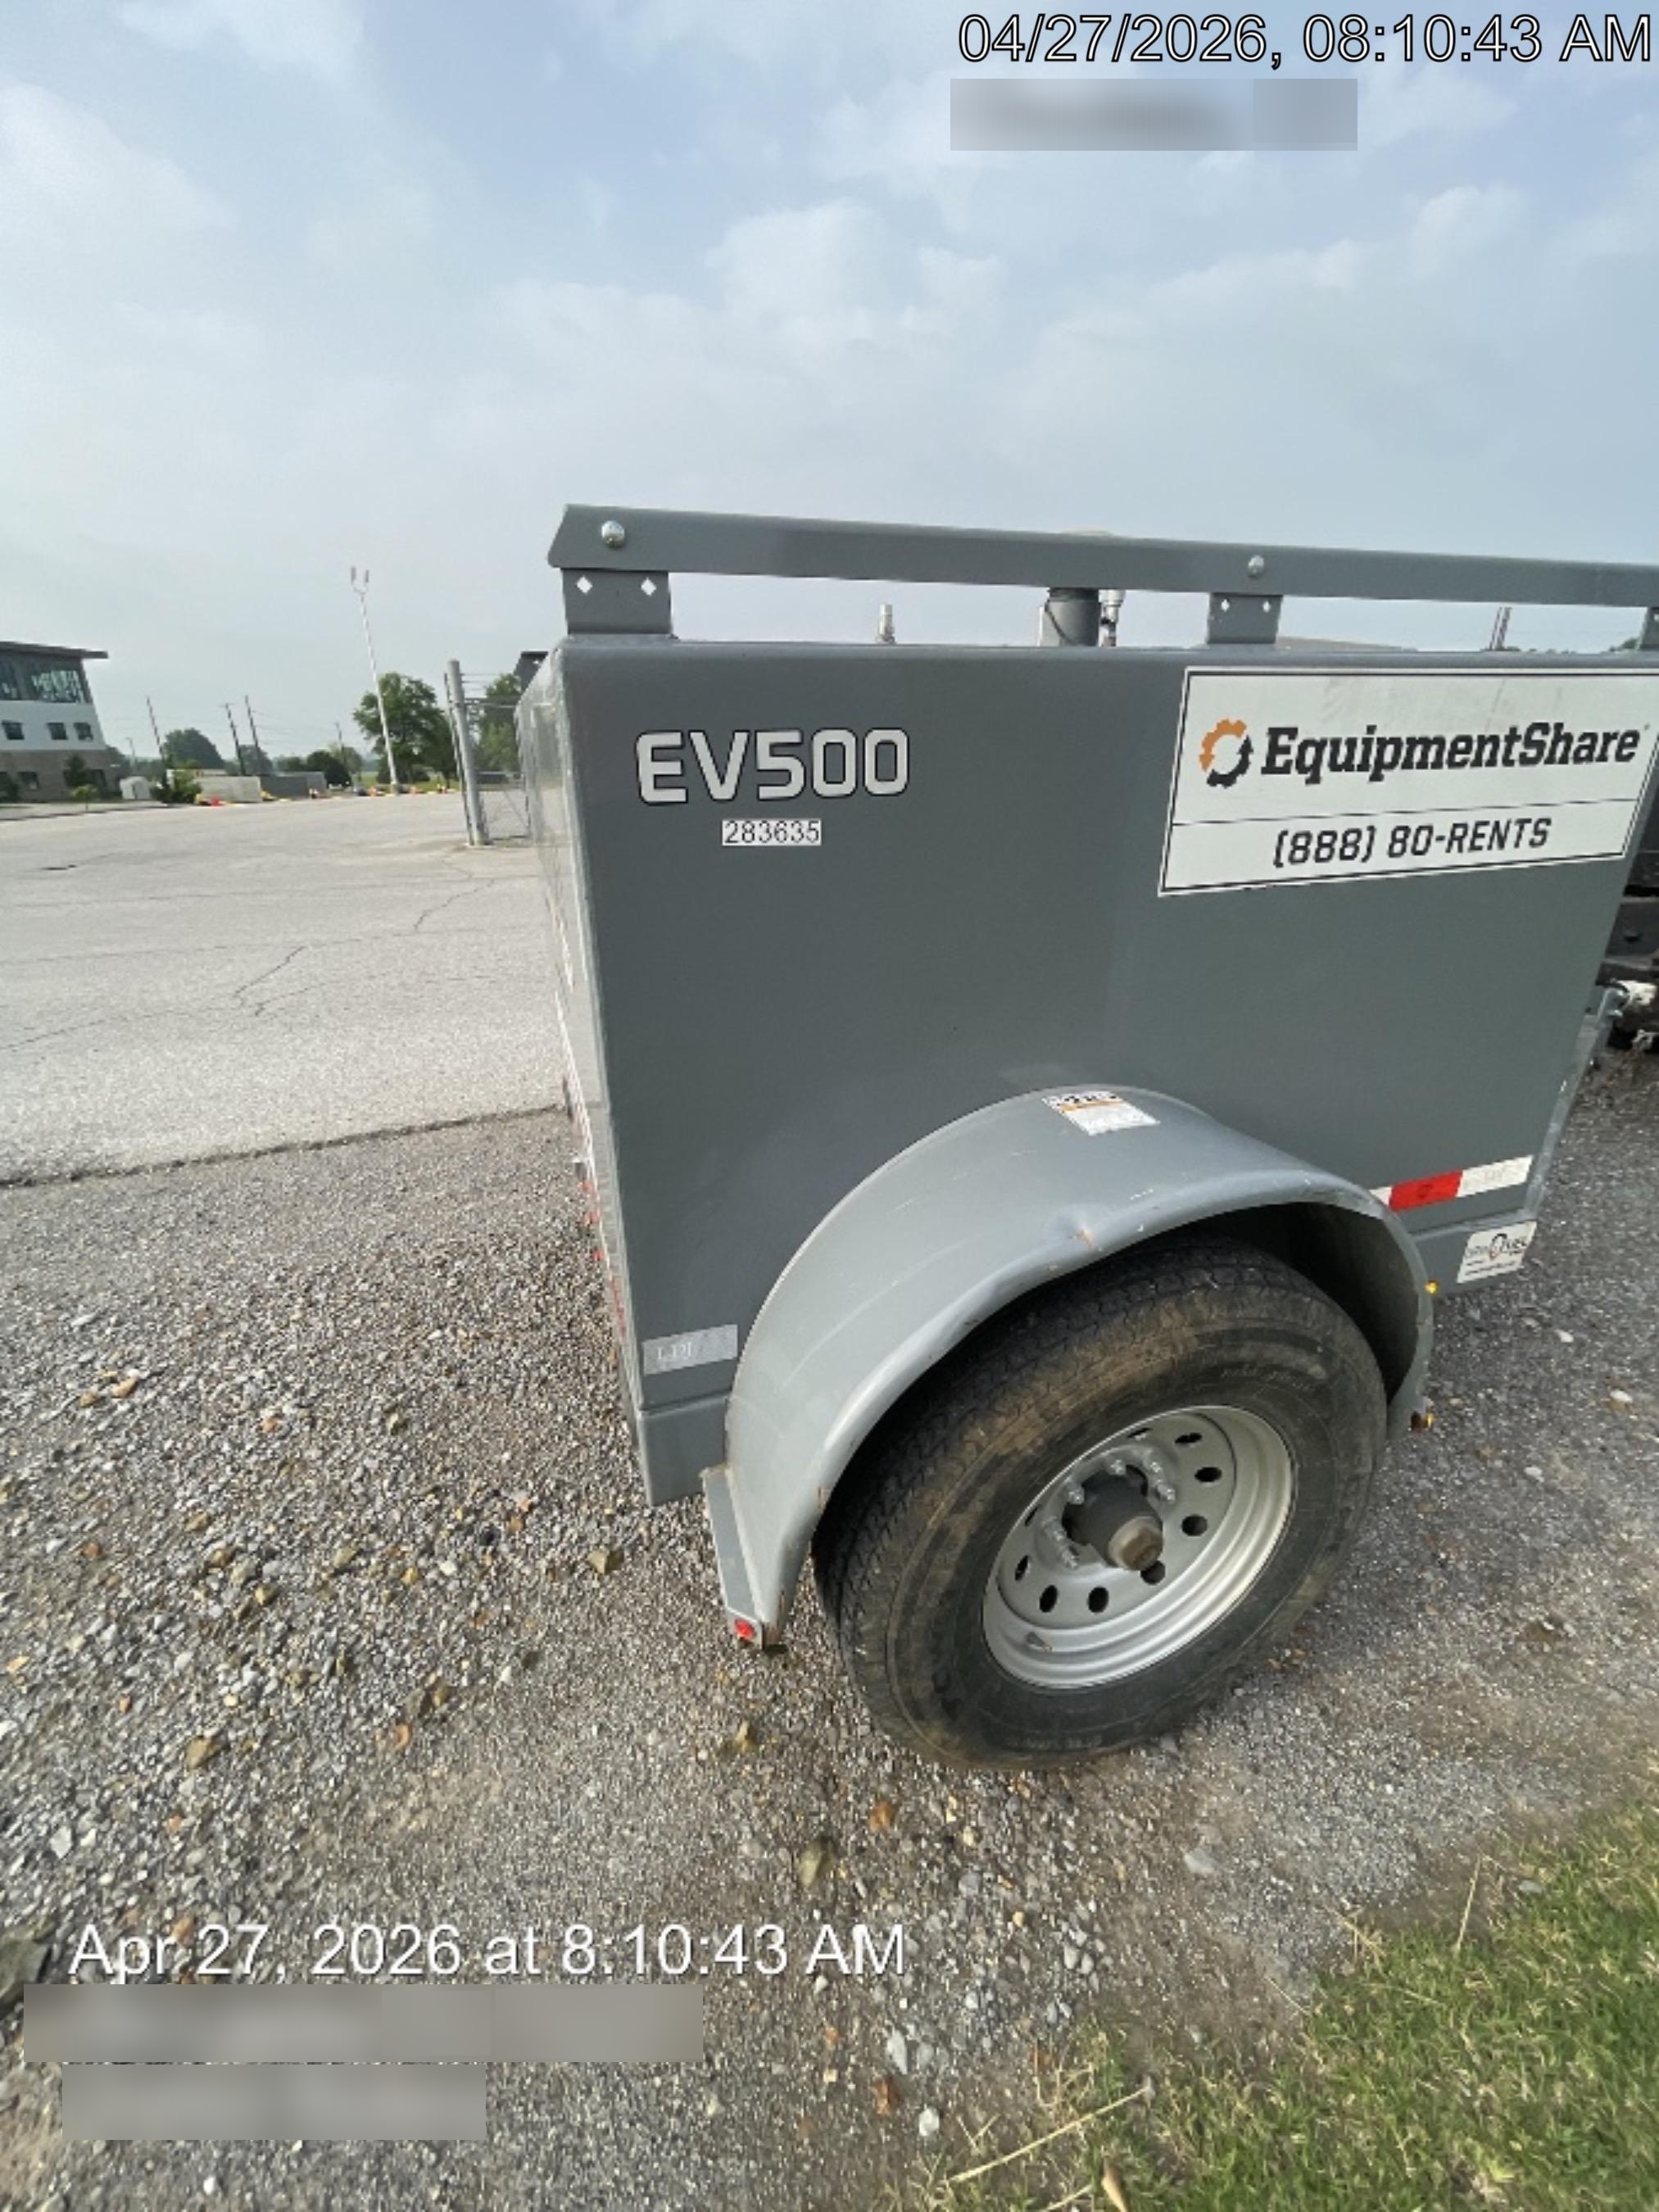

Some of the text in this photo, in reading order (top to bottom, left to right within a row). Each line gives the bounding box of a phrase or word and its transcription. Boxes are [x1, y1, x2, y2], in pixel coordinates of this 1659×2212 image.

[635, 728, 909, 805] EV500
[1261, 723, 1639, 785] EquipmentShare
[724, 820, 819, 844] 283635
[1273, 818, 1552, 868] (888) 80-RENTS
